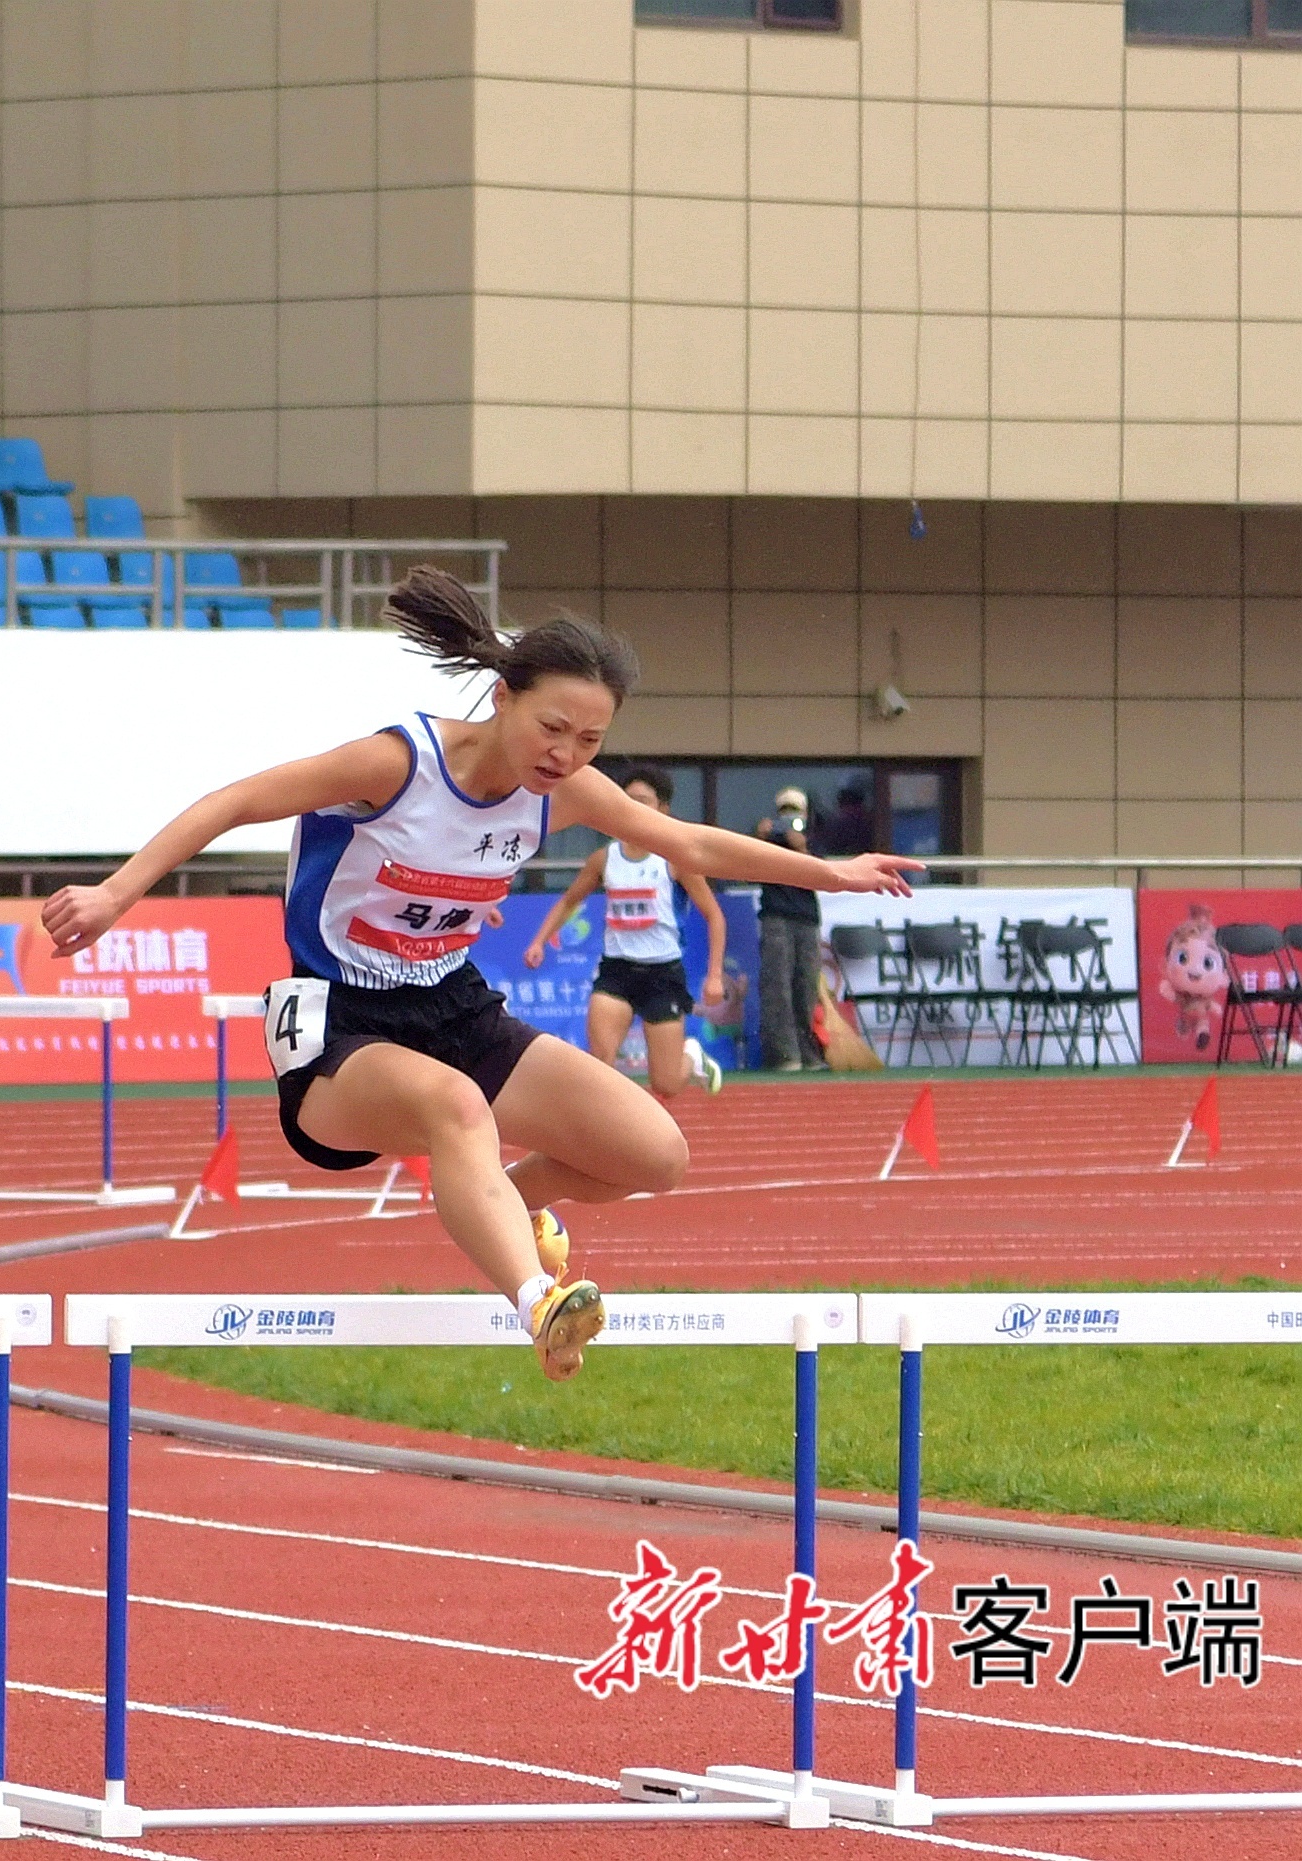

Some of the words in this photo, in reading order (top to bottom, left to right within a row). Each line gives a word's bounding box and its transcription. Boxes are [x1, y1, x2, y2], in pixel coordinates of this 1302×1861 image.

[60, 978, 125, 995] FEIYUE
[135, 977, 211, 994] SPORTS
[275, 994, 304, 1052] 4
[256, 1309, 336, 1327] 金陵体育
[1044, 1308, 1120, 1325] 金陵体育
